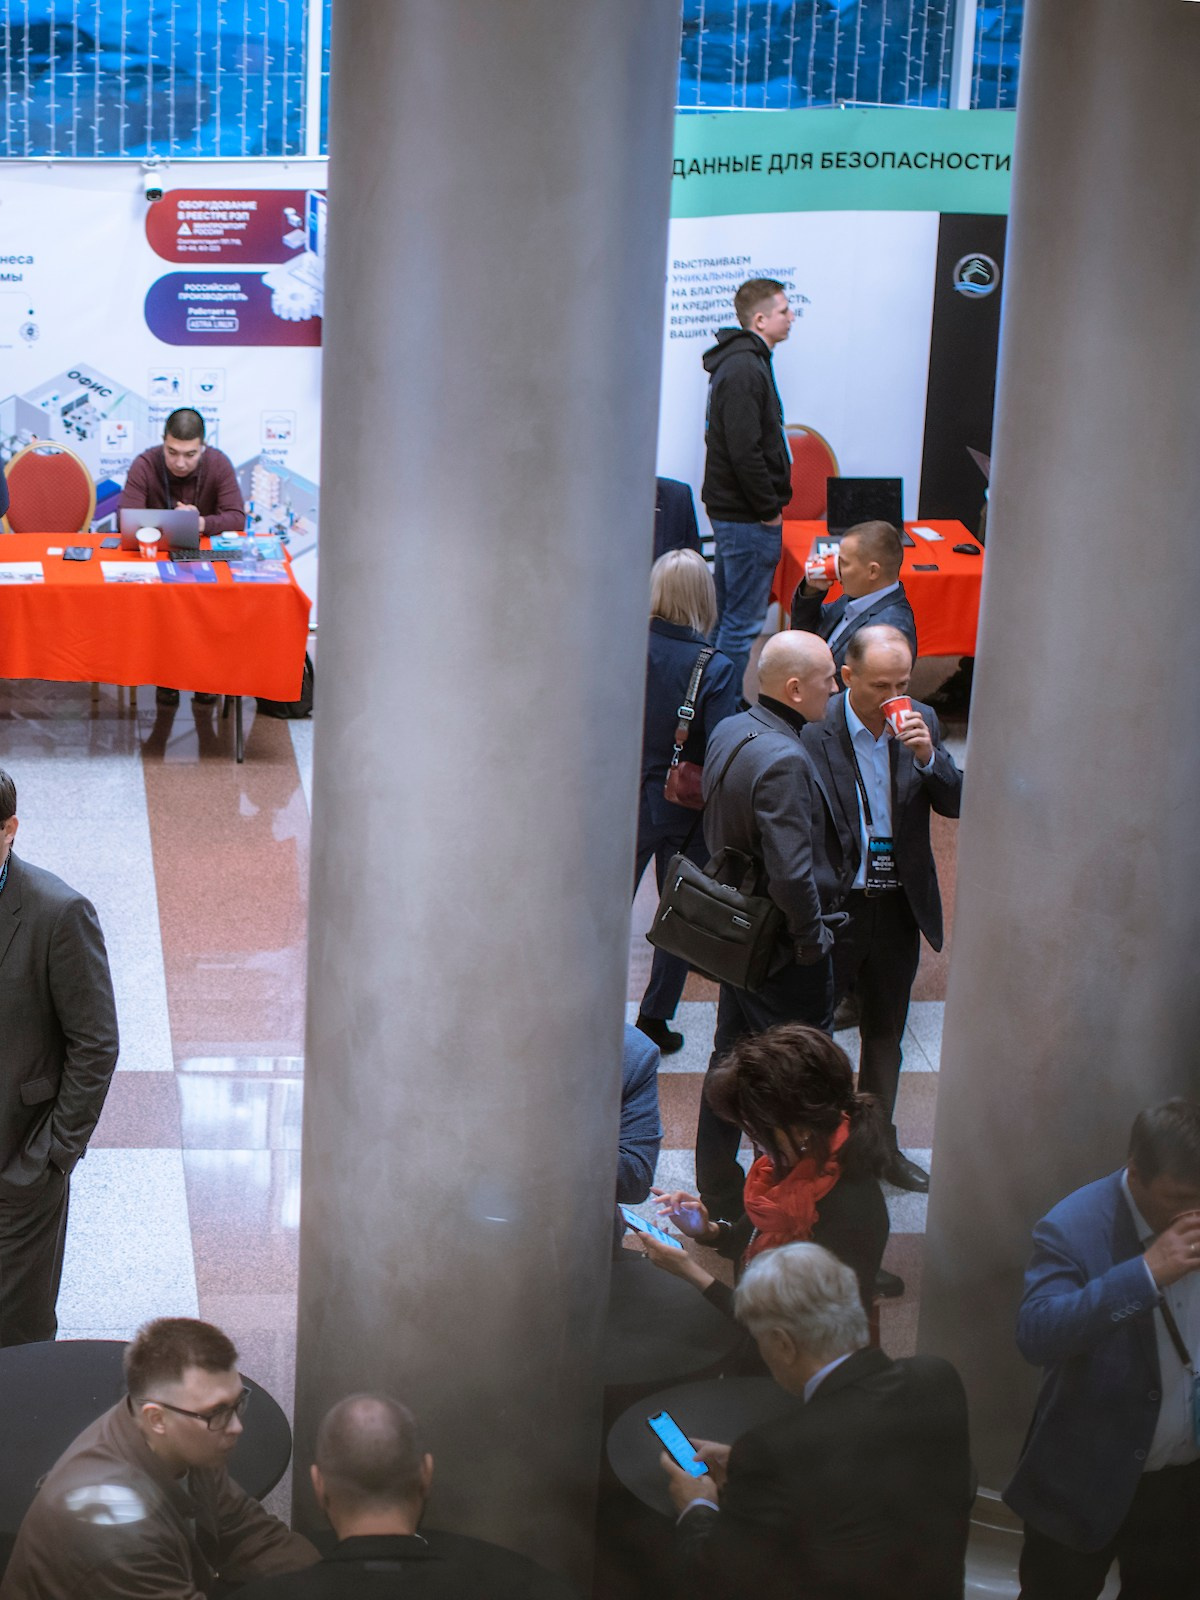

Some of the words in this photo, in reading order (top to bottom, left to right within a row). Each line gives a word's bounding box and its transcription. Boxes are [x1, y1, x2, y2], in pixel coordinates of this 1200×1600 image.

[672, 154, 762, 179] ДАННЫЕ
[768, 153, 813, 175] ДЛЯ
[821, 152, 1011, 171] БЕЗОПАСНОСТИ
[673, 256, 751, 269] ВЫСТРАИВАЕМ
[672, 268, 745, 283] УНИКАЛЬНЫЙ
[748, 267, 797, 279] СКОРИНГ
[672, 287, 687, 297] НА
[671, 303, 680, 311] И
[670, 311, 738, 325] ВЕРИФИЦИР
[670, 329, 708, 339] ВАШИХ
[67, 371, 112, 397] ОФИС
[261, 448, 289, 456] Active
